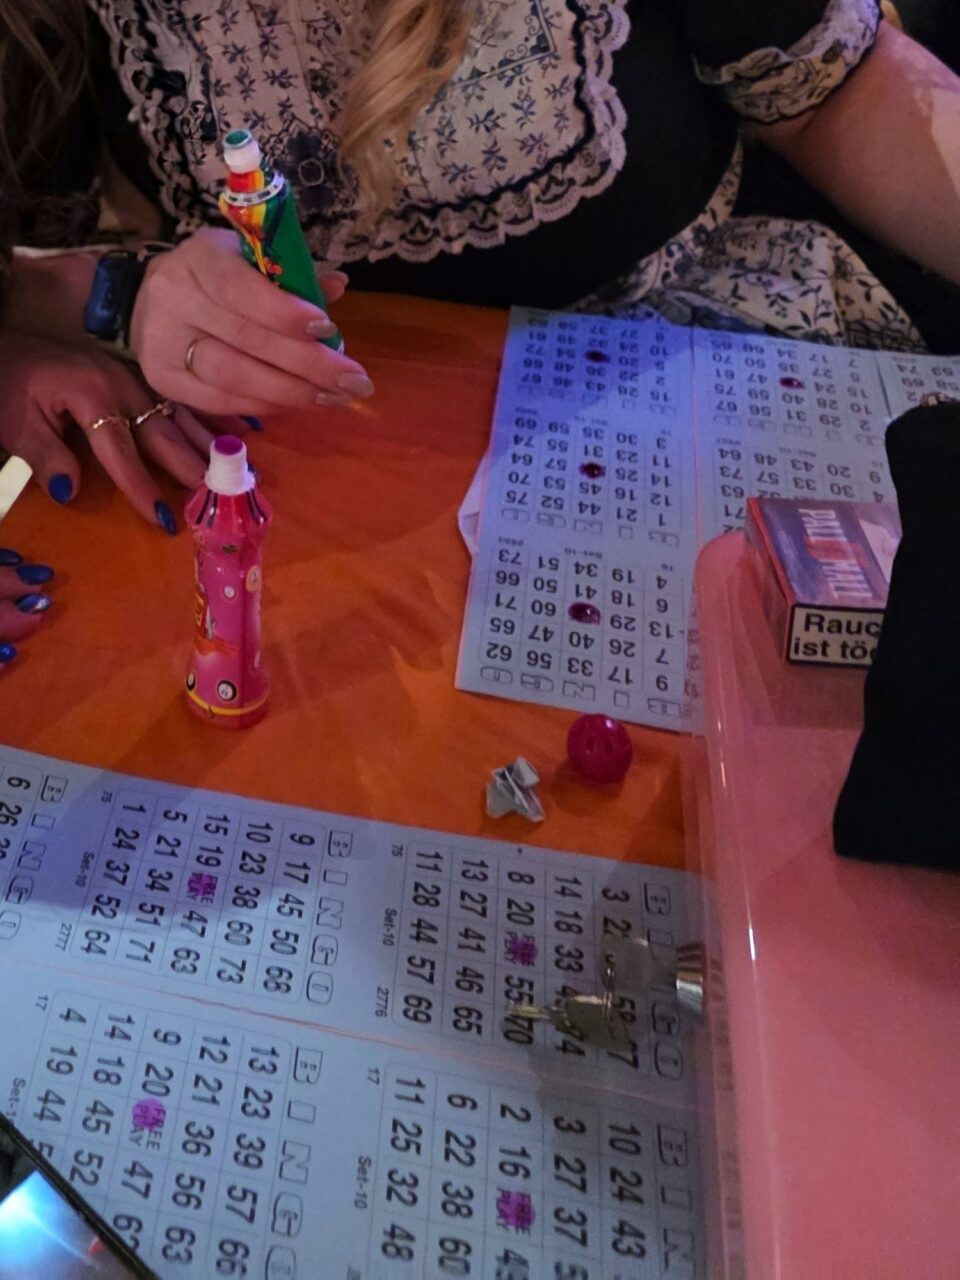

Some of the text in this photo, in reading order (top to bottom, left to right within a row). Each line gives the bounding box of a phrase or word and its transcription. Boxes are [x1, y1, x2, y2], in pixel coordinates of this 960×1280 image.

[495, 569, 669, 614] 6 18 41 50 66
[798, 508, 873, 599] PALL MALL
[485, 640, 669, 692] 9 17 33 56 62
[489, 616, 670, 666] 7 26 40 47 65
[494, 591, 675, 640] 13 29 60 71
[793, 637, 831, 657] ist
[6, 775, 32, 791] 6
[74, 850, 95, 887] Set-10
[79, 804, 147, 956] 1 24 37 52 64
[124, 809, 189, 964] 5 21 34 51 71
[169, 814, 232, 975] 15 19 47 63
[215, 821, 274, 985] 10 23 38 60 73
[262, 832, 316, 994] 9 17 45 50 68
[505, 870, 536, 926] 8 20
[553, 875, 585, 972] 14 18 33
[54, 923, 74, 951] 2777
[402, 851, 444, 1024] 11 28 44 57 69
[451, 859, 490, 1037] 13 27 41 46 65
[32, 1007, 88, 1123] 4 19 44
[69, 1014, 136, 1187] 14 18 45 52
[140, 1028, 183, 1098] 9 20
[120, 1159, 154, 1200] 47
[171, 1035, 232, 1211] 12 21 36 56
[224, 1045, 281, 1225] 13 23 39 57
[380, 1077, 427, 1262] 11 25 32 48
[440, 1093, 479, 1219] 6 22 38
[497, 1103, 533, 1180] 2 16
[552, 1115, 589, 1248] 3 27 37
[608, 1124, 647, 1260] 10 24 43
